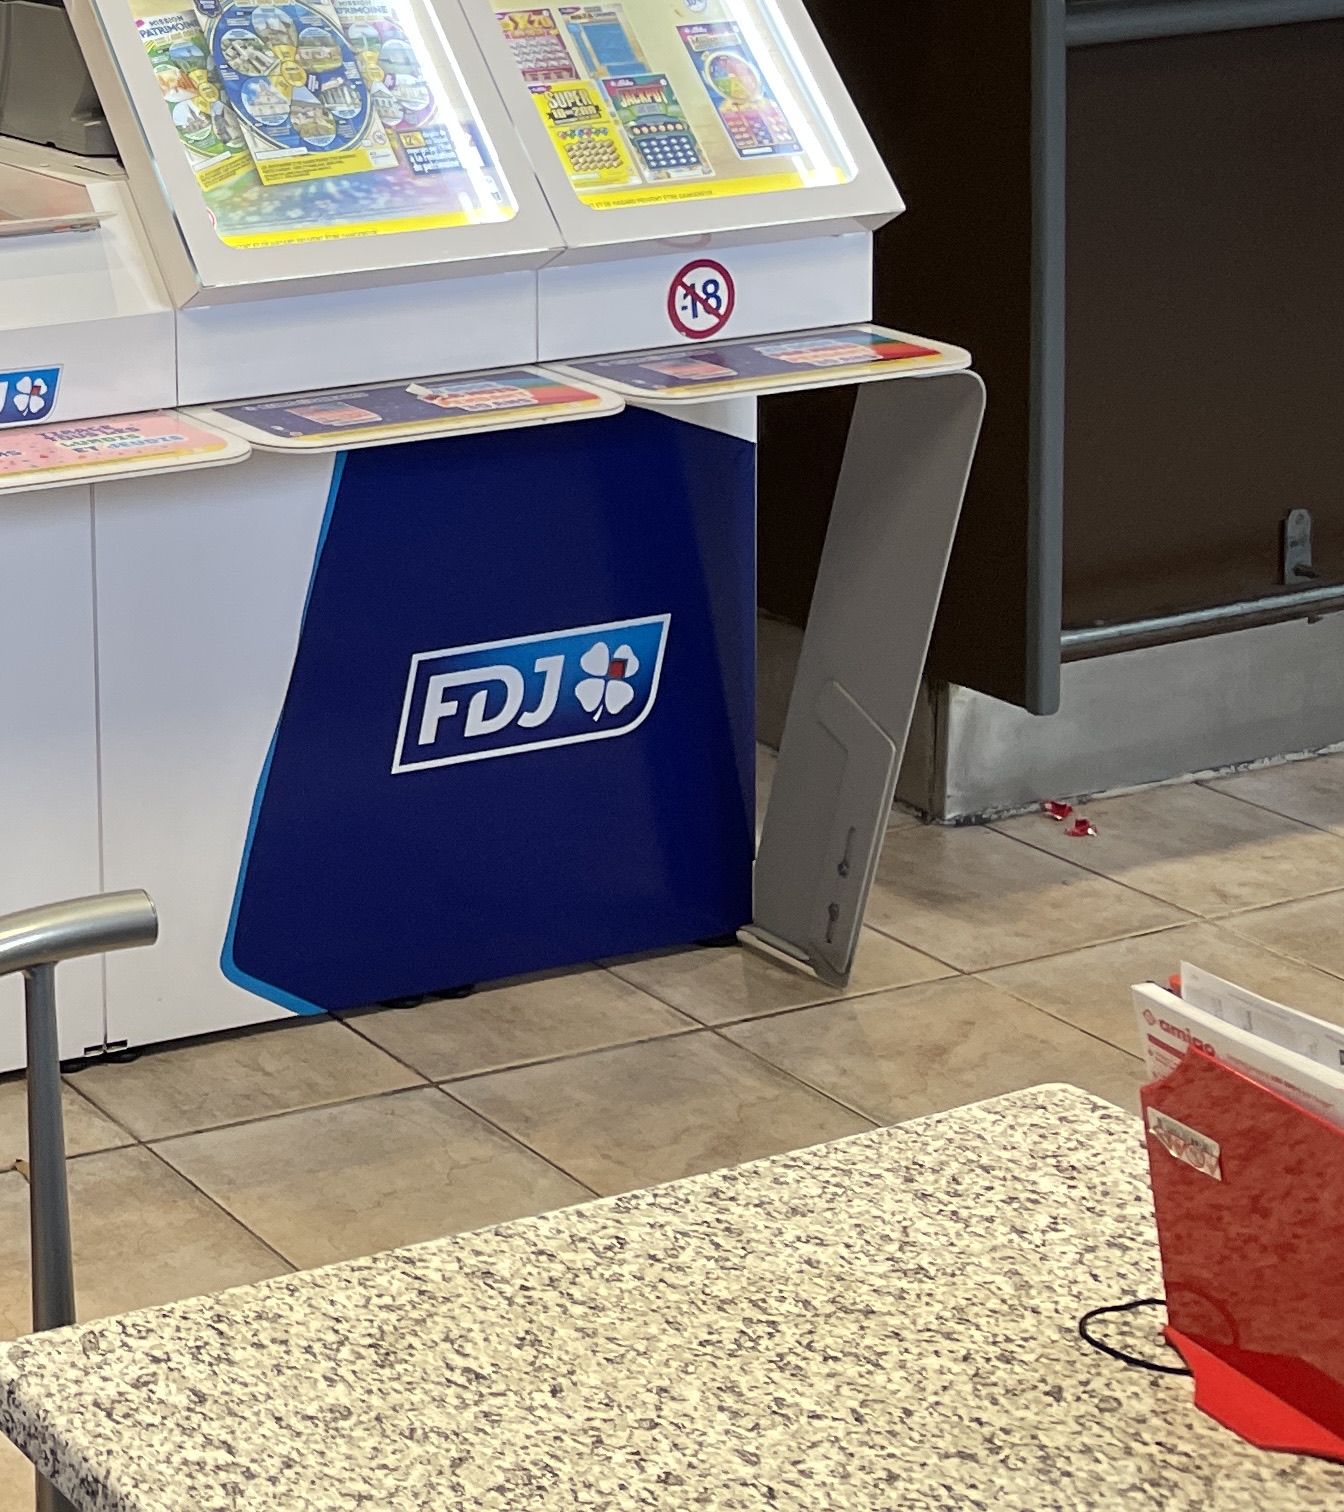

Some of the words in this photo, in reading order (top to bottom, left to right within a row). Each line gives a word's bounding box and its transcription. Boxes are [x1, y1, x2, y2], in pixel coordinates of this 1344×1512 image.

[544, 89, 594, 110] SUPER
[679, 278, 723, 322] -18
[417, 653, 566, 746] FDJ
